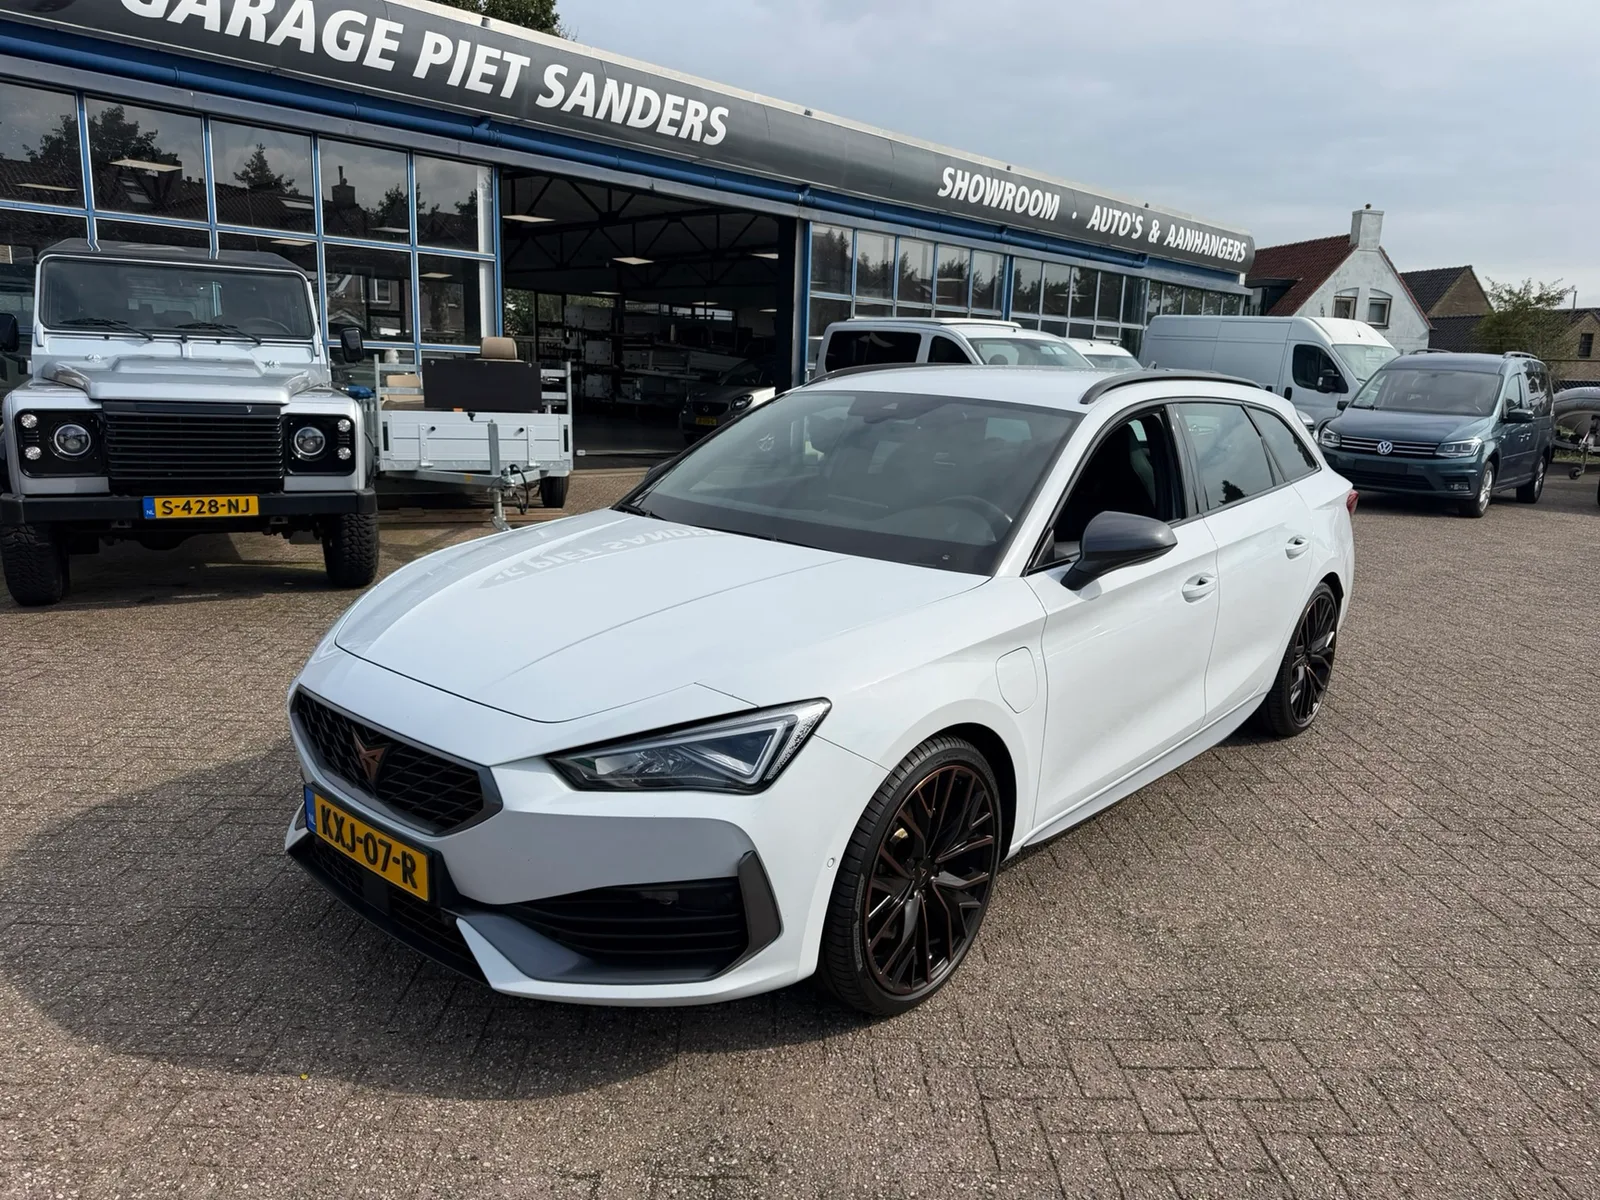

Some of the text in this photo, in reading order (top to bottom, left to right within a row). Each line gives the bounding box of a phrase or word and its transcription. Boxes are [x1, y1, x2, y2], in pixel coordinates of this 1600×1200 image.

[412, 30, 531, 99] PIET
[535, 64, 730, 146] SANDERS
[937, 167, 1247, 263] SHOWROOM AUTO'S & AANHANGERS
[161, 498, 250, 515] S-428-NJ
[320, 804, 418, 889] KXJ-07-R
